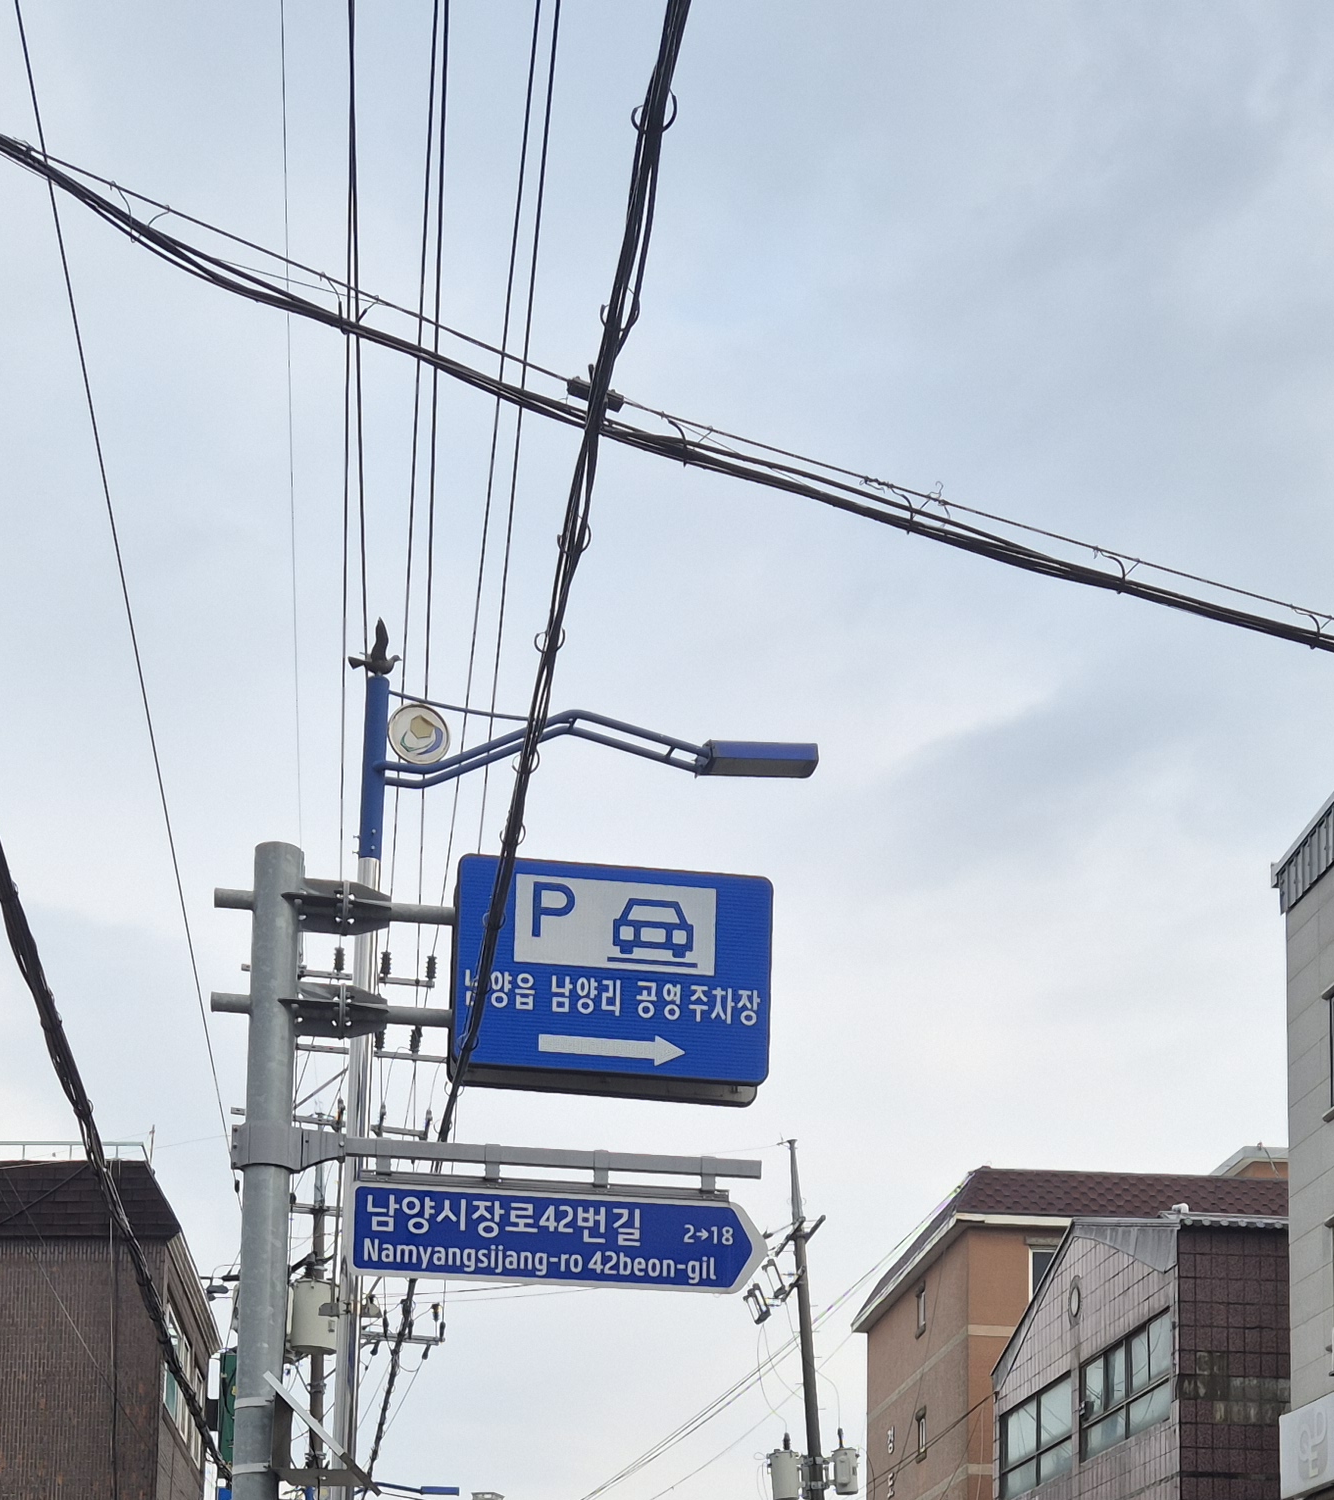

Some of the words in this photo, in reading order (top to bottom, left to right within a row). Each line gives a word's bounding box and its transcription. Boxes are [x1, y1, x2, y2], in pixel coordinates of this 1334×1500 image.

[532, 881, 576, 938] P
[551, 975, 621, 1017] 남양리
[636, 981, 761, 1026] 공영주차장
[366, 1193, 642, 1247] 남양시장로42번길
[363, 1238, 584, 1277] Namyangsijang-ro
[587, 1249, 717, 1285] 42beon-gil
